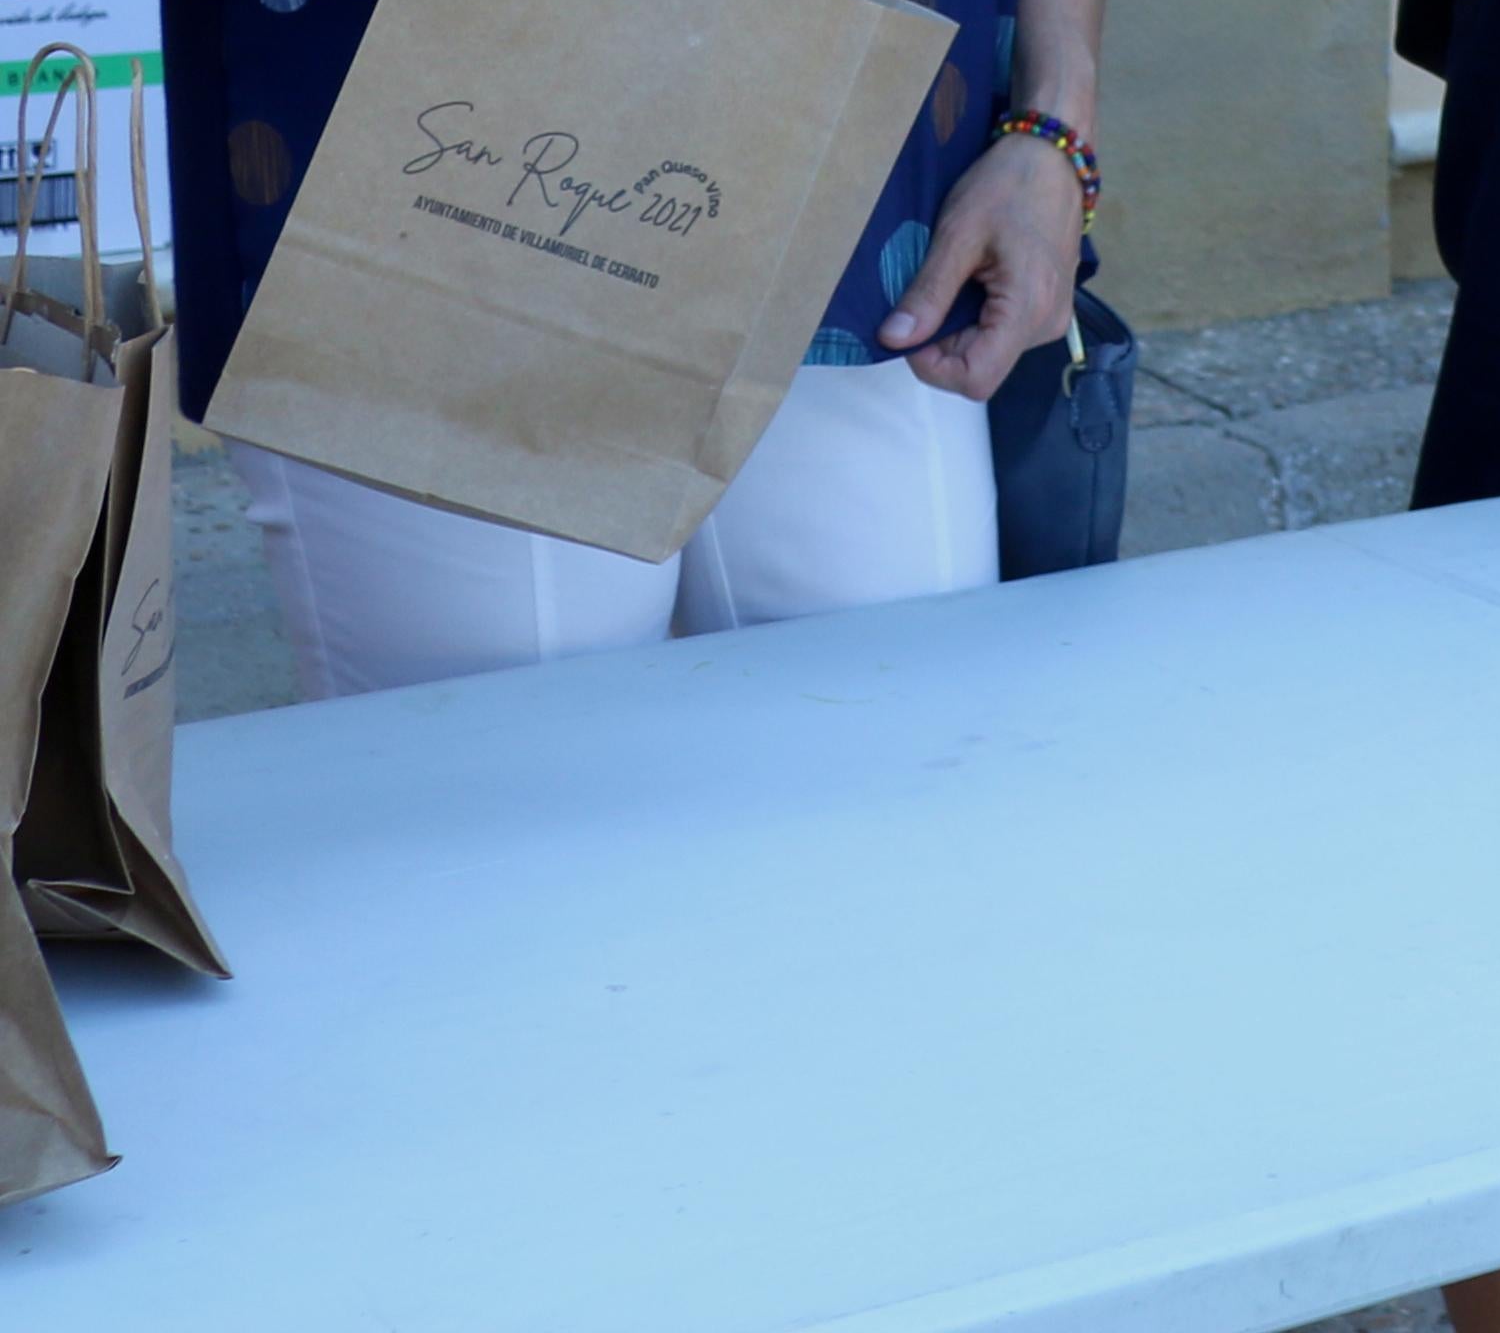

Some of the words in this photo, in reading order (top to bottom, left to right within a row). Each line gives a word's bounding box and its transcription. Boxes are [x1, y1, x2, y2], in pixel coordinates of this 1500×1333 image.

[402, 100, 504, 175] San
[506, 131, 633, 238] Roque
[639, 193, 703, 237] 2021
[633, 168, 661, 195] Pan
[661, 159, 708, 184] Queso
[705, 180, 722, 219] Vino
[412, 194, 503, 235] AYUNTAMIENTO
[502, 221, 520, 241] DE
[519, 228, 591, 267] VILLAMURIEL
[590, 253, 608, 272] DE
[607, 259, 661, 290] CERRATO
